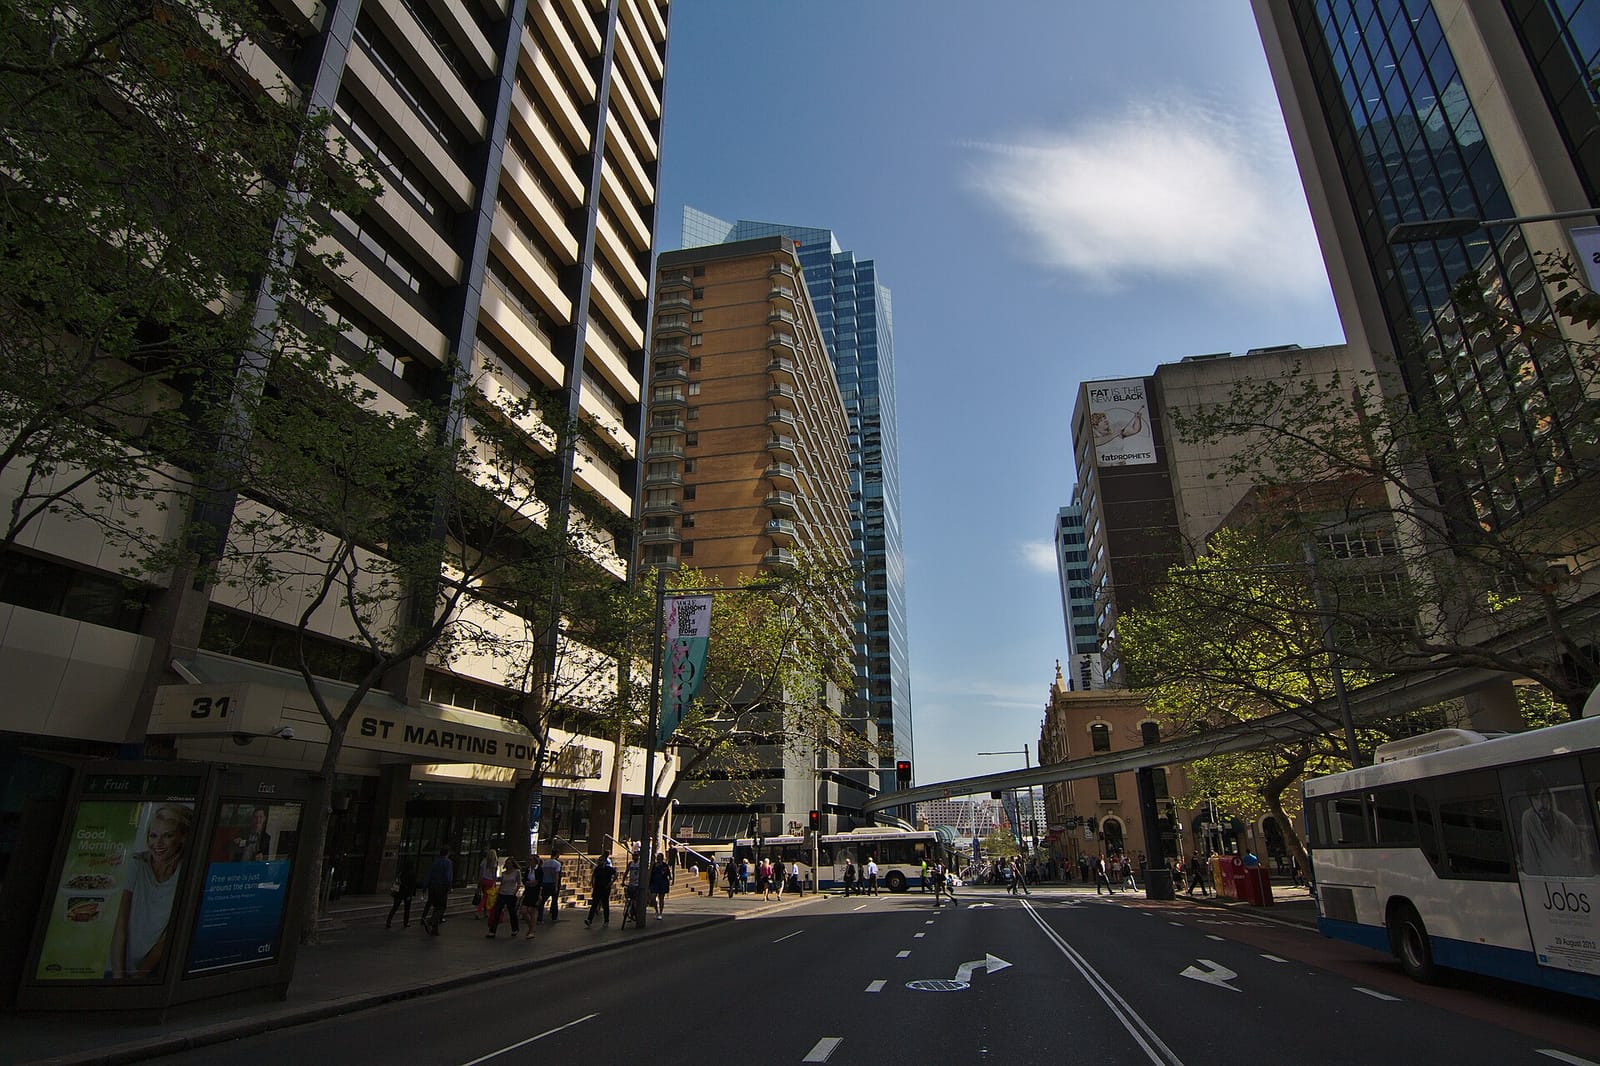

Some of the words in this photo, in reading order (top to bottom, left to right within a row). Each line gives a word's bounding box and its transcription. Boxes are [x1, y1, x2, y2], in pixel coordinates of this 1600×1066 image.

[1090, 389, 1109, 397] FAT
[1111, 387, 1120, 396] IS
[1122, 386, 1143, 394] THE
[1091, 396, 1112, 404] NEW
[1113, 393, 1143, 402] BLACK
[1101, 452, 1151, 461] fatPROPHETS
[190, 697, 231, 719] 31
[360, 717, 394, 739] ST
[404, 725, 497, 755] MARTINS
[504, 742, 559, 765] TOWER
[104, 778, 130, 790] Fruit
[77, 828, 106, 839] Good
[79, 839, 125, 852] Morning
[211, 874, 226, 882] Free
[247, 873, 261, 882] just
[210, 883, 232, 892] around
[233, 882, 243, 890] the
[1543, 881, 1591, 913] Jobs
[258, 943, 271, 953] citi
[1563, 938, 1581, 948] August
